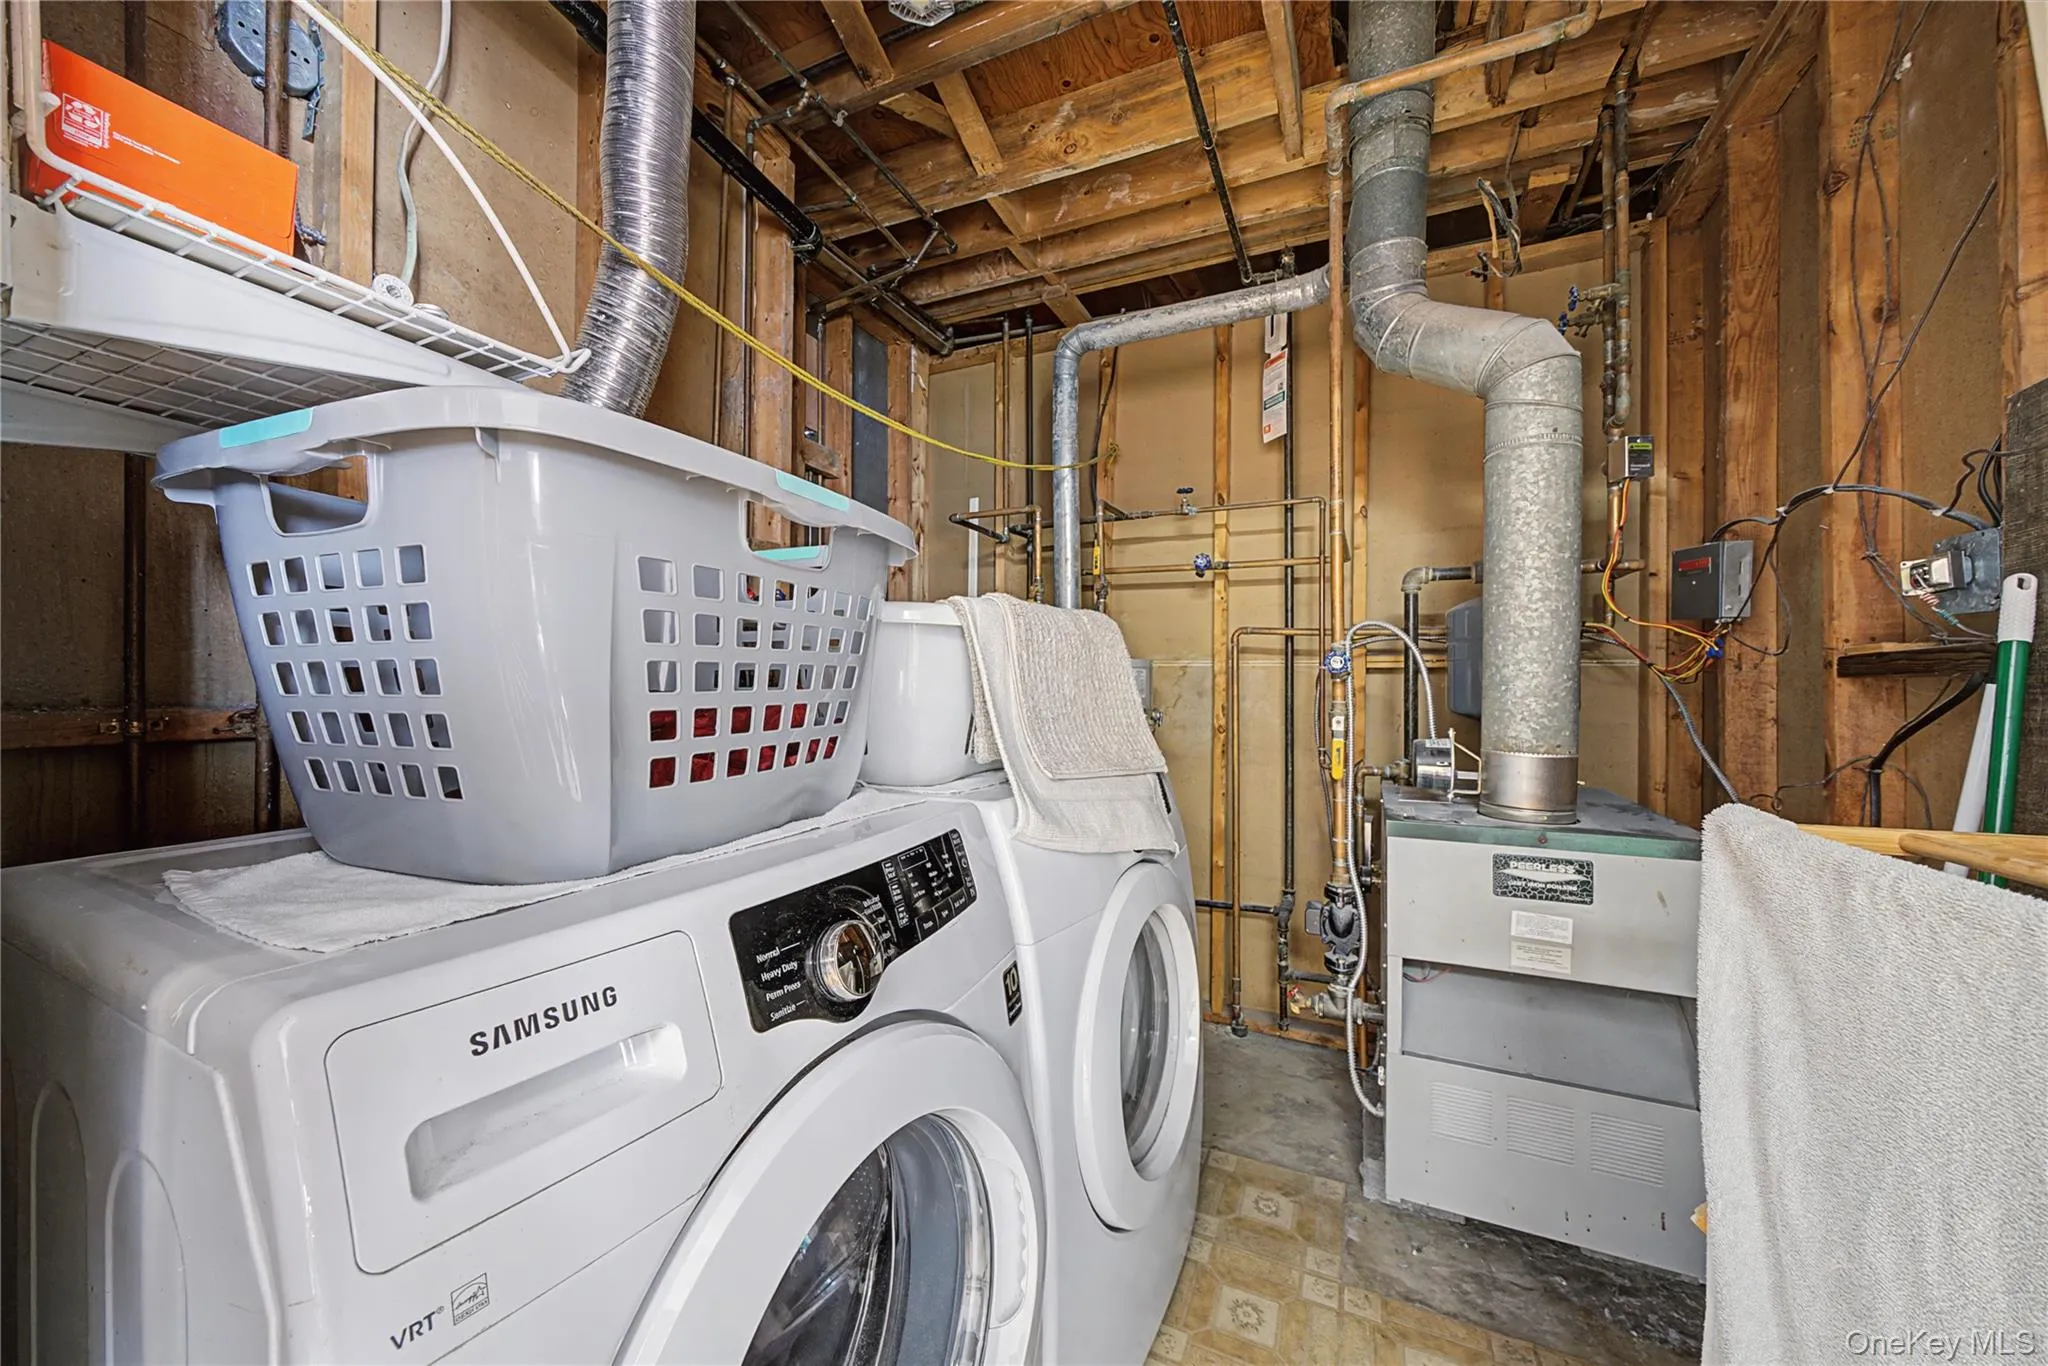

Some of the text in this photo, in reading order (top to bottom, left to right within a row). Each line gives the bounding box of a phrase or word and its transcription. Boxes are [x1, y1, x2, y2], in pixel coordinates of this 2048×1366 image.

[1509, 860, 1576, 874] PEERLESS
[756, 947, 781, 964] Normal
[760, 960, 799, 983] Heavy Duty
[1005, 966, 1018, 996] 10
[765, 988, 785, 1003] Perm
[469, 985, 618, 1057] SAMSUNG
[770, 1003, 797, 1021] Sanitize
